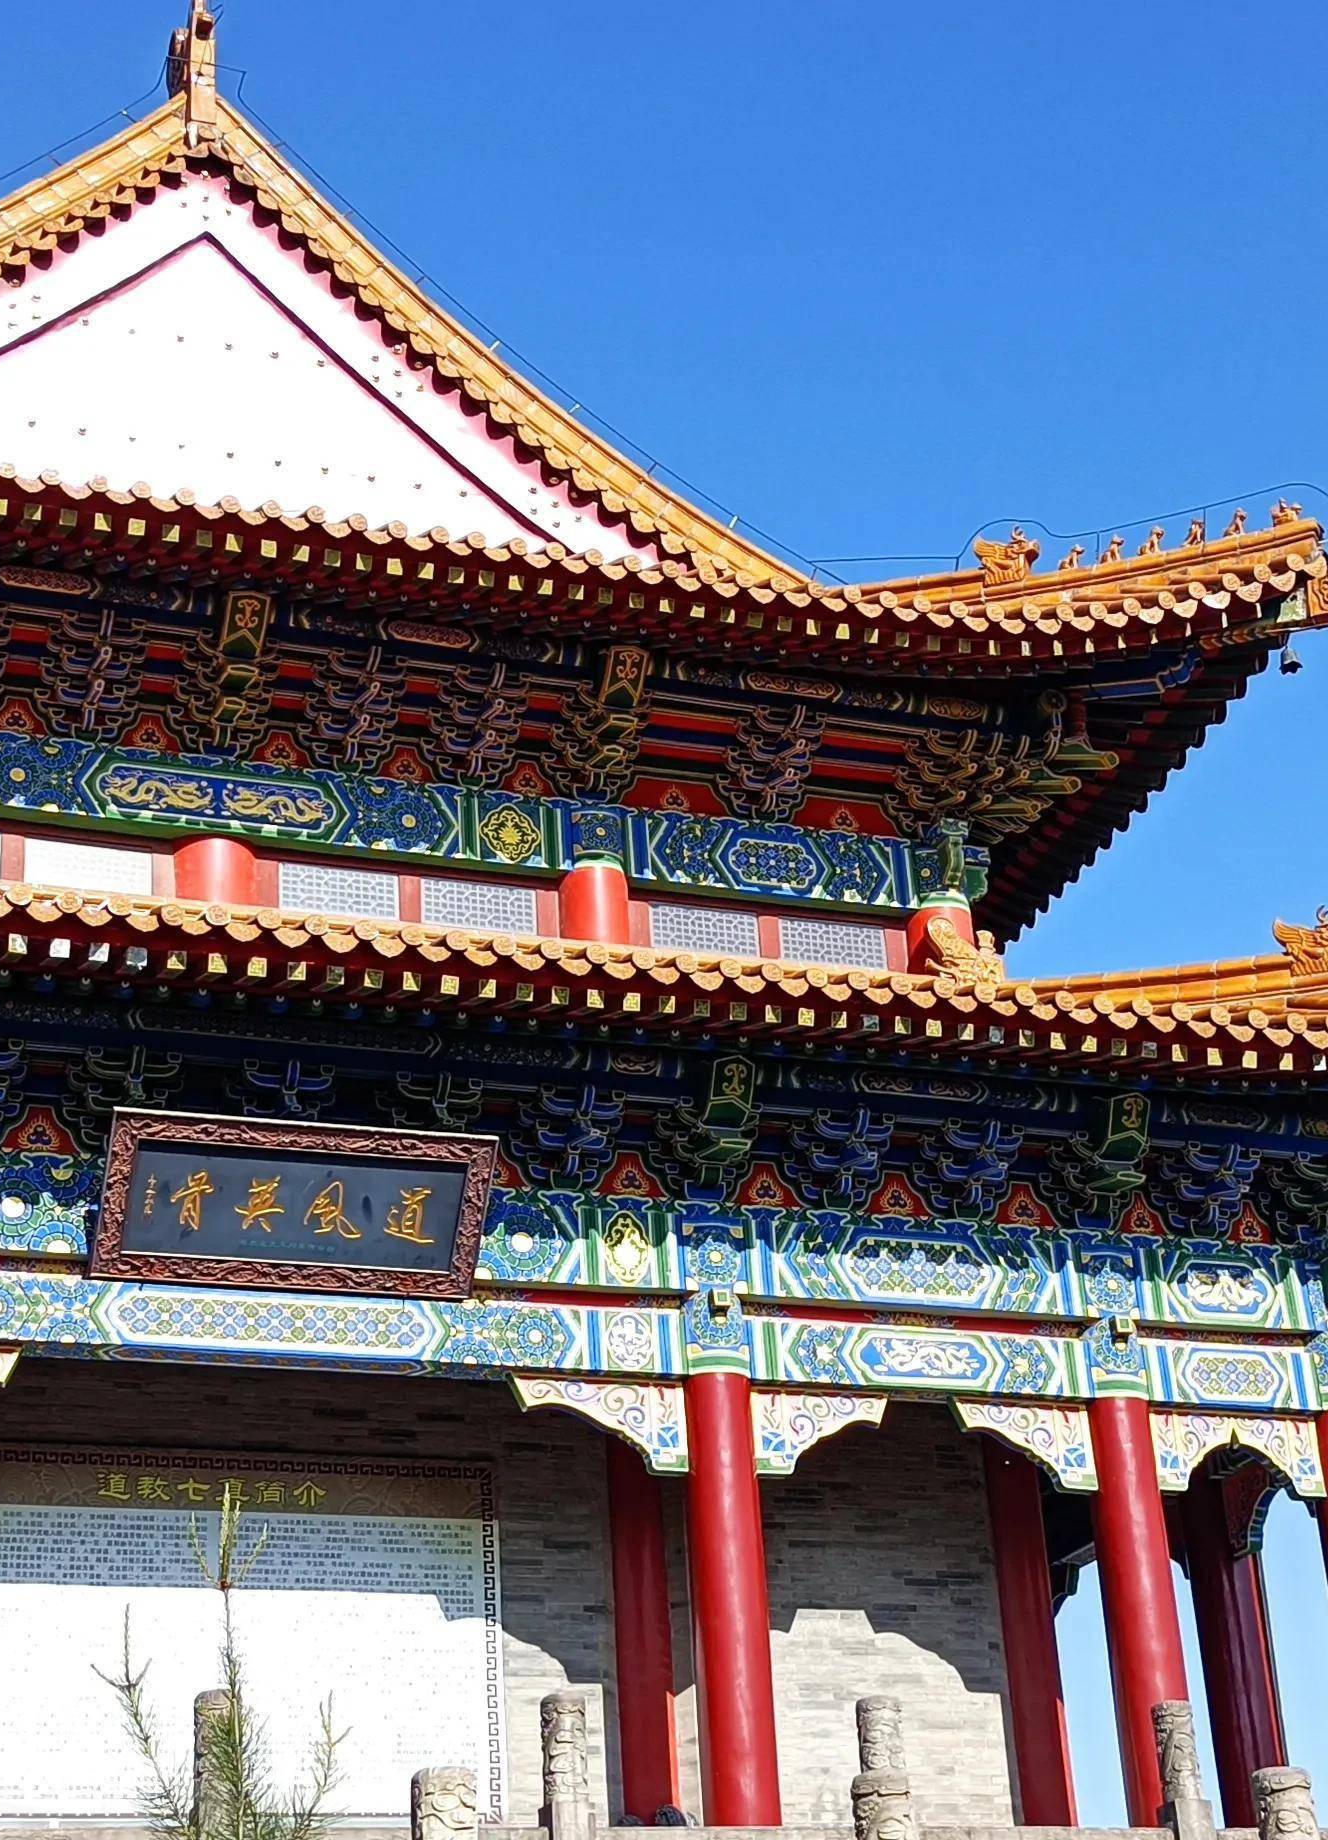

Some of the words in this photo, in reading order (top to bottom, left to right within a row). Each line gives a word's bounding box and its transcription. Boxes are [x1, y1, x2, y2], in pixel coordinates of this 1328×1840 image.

[97, 1472, 327, 1507] 道教七真简介
